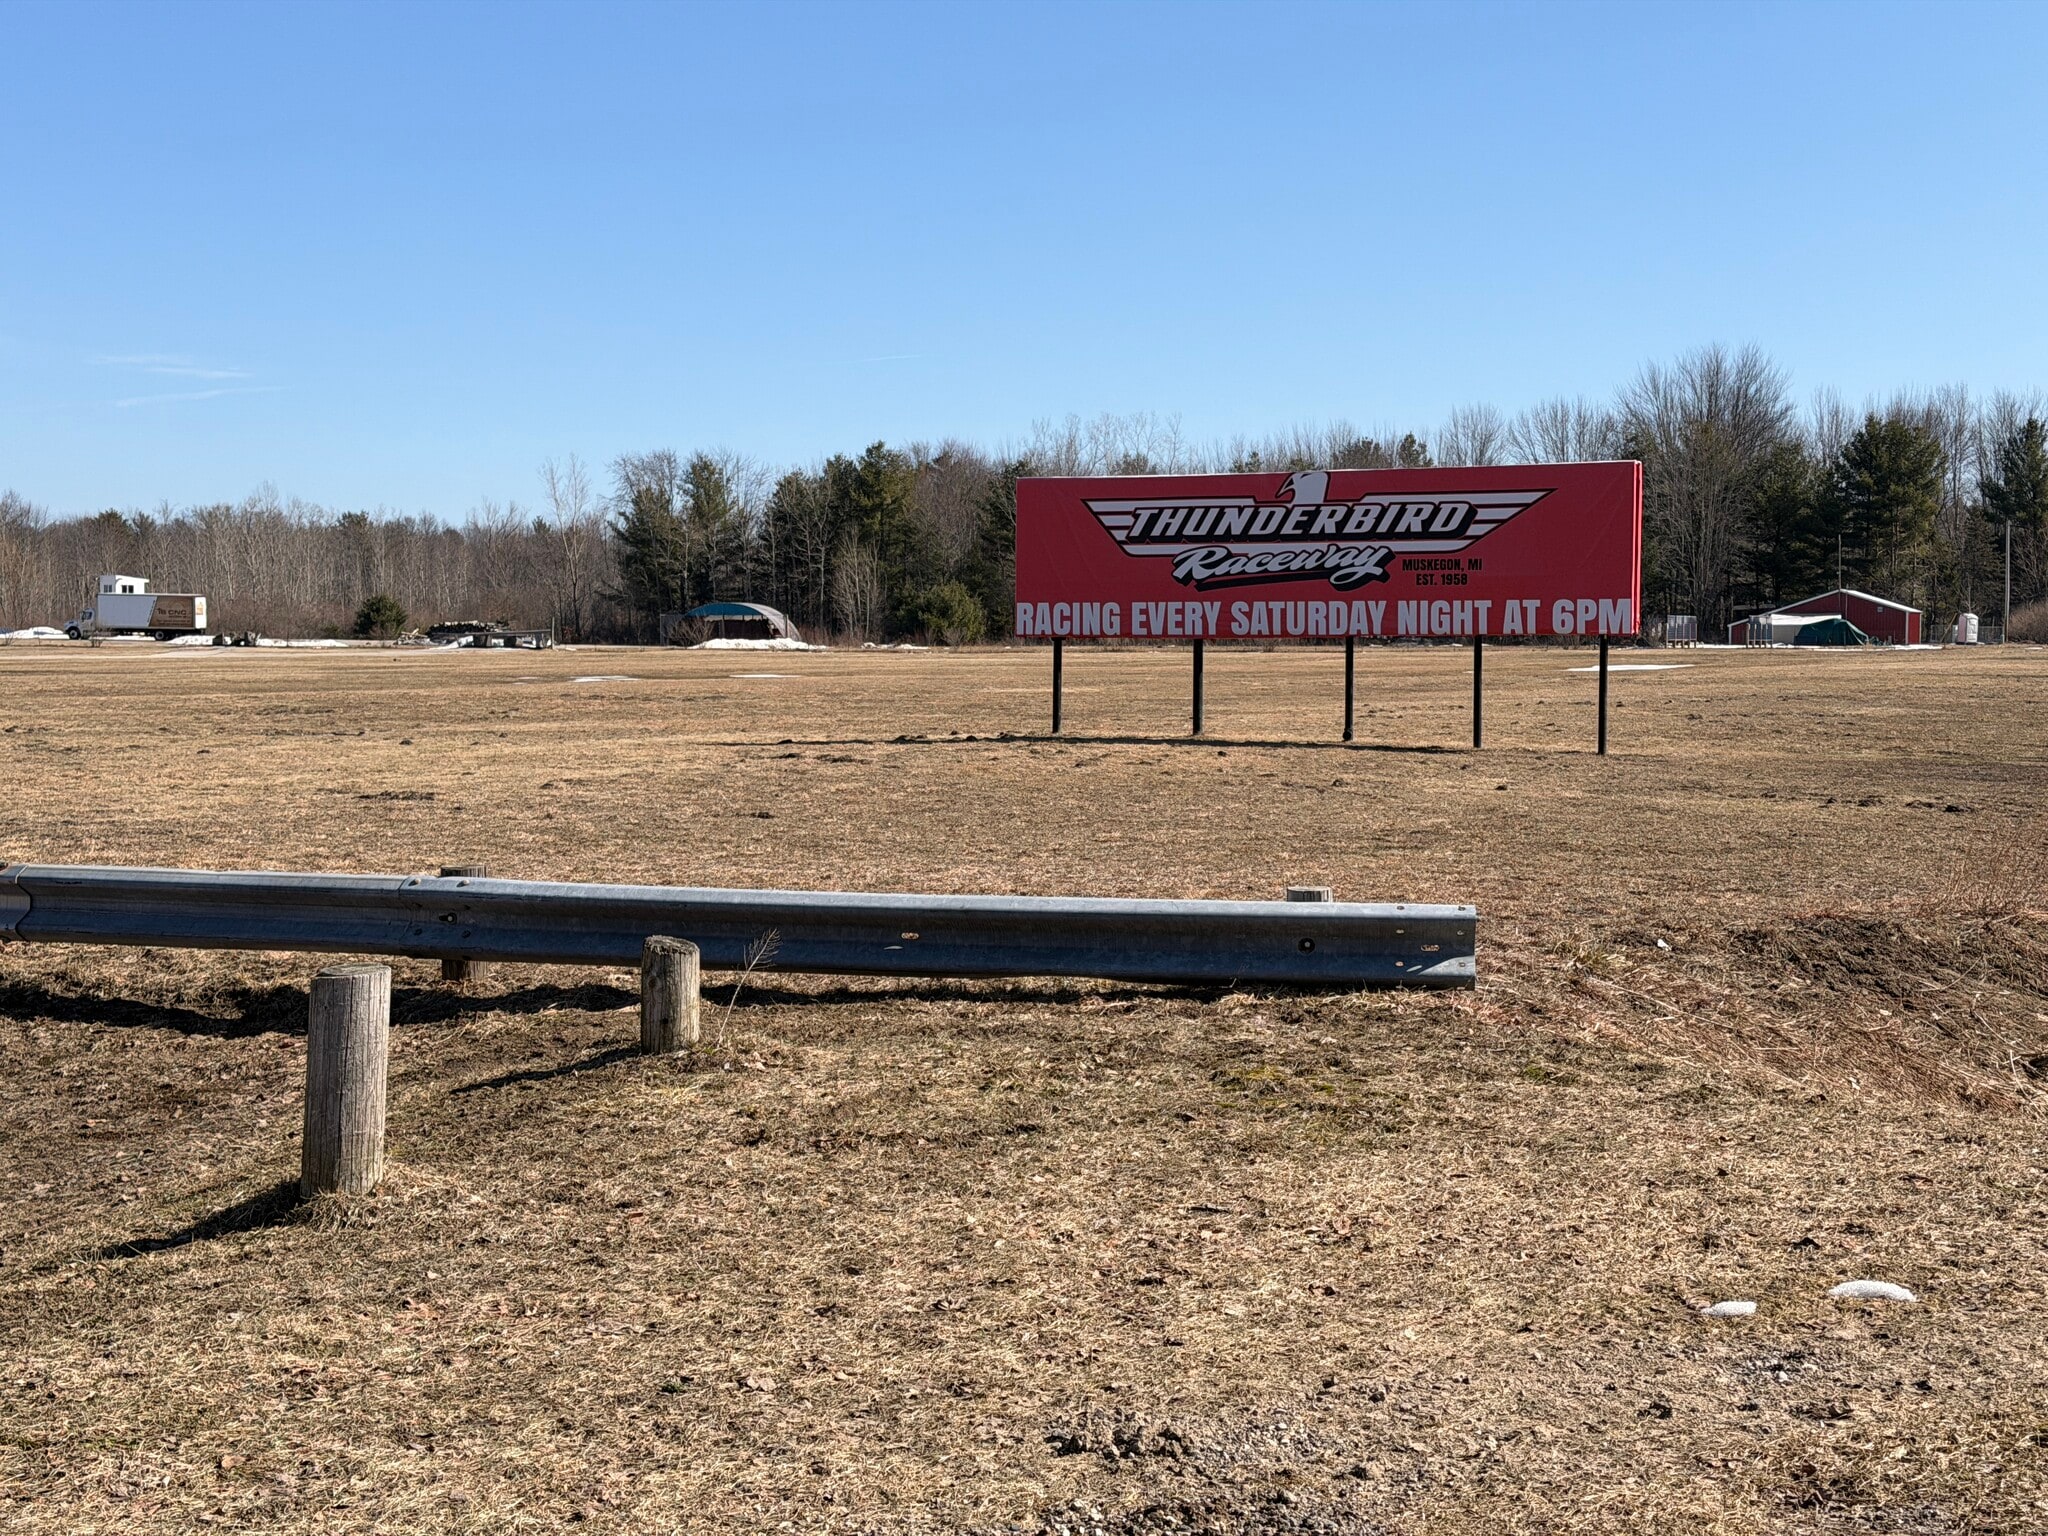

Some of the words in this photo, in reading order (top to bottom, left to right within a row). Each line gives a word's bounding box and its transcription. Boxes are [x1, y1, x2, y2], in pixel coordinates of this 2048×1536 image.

[1128, 502, 1473, 538] THUNDERBIRD
[1172, 545, 1391, 585] Raceway
[1402, 559, 1464, 572] MUSKEGON,
[1468, 559, 1482, 571] MI
[1416, 574, 1437, 586] EST.
[1441, 574, 1468, 586] 1958
[1016, 602, 1121, 636] RACING
[1131, 601, 1222, 636] EVERY
[1230, 600, 1387, 636] SATURDAY
[1397, 600, 1493, 635] NIGHT
[1502, 600, 1541, 635] AT
[1551, 599, 1632, 634] 6PM
